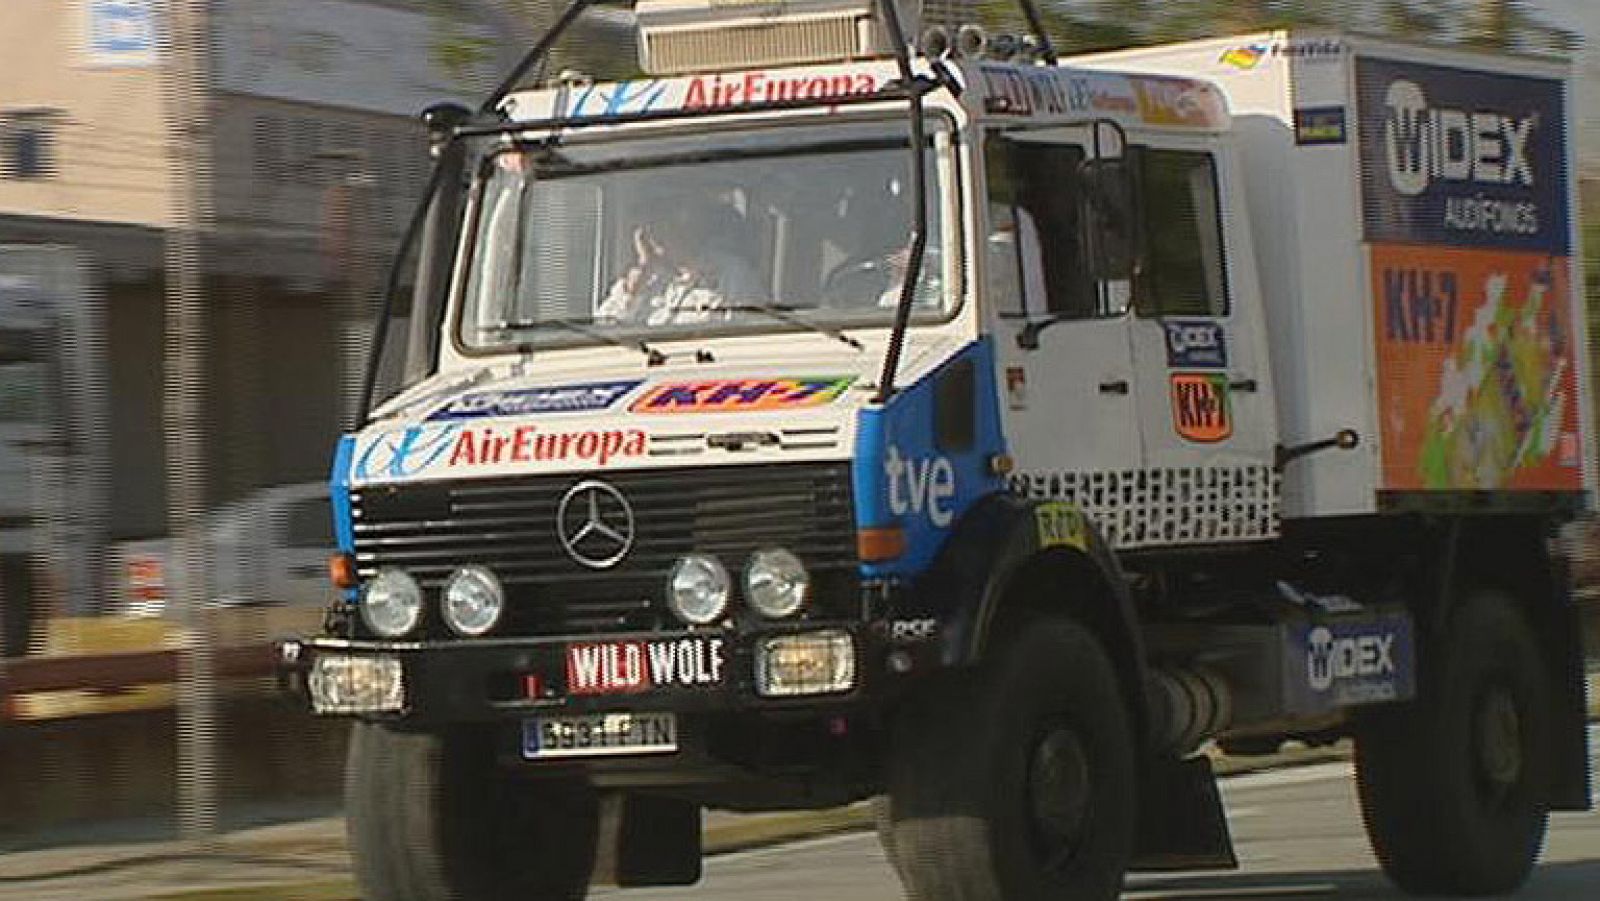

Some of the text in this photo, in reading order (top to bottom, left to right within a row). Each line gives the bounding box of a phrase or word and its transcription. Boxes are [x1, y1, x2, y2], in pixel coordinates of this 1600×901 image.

[1386, 80, 1538, 195] WIDEX
[449, 424, 646, 467] AirEuropa
[884, 445, 956, 529] tve
[572, 639, 724, 688] WILD WOLF
